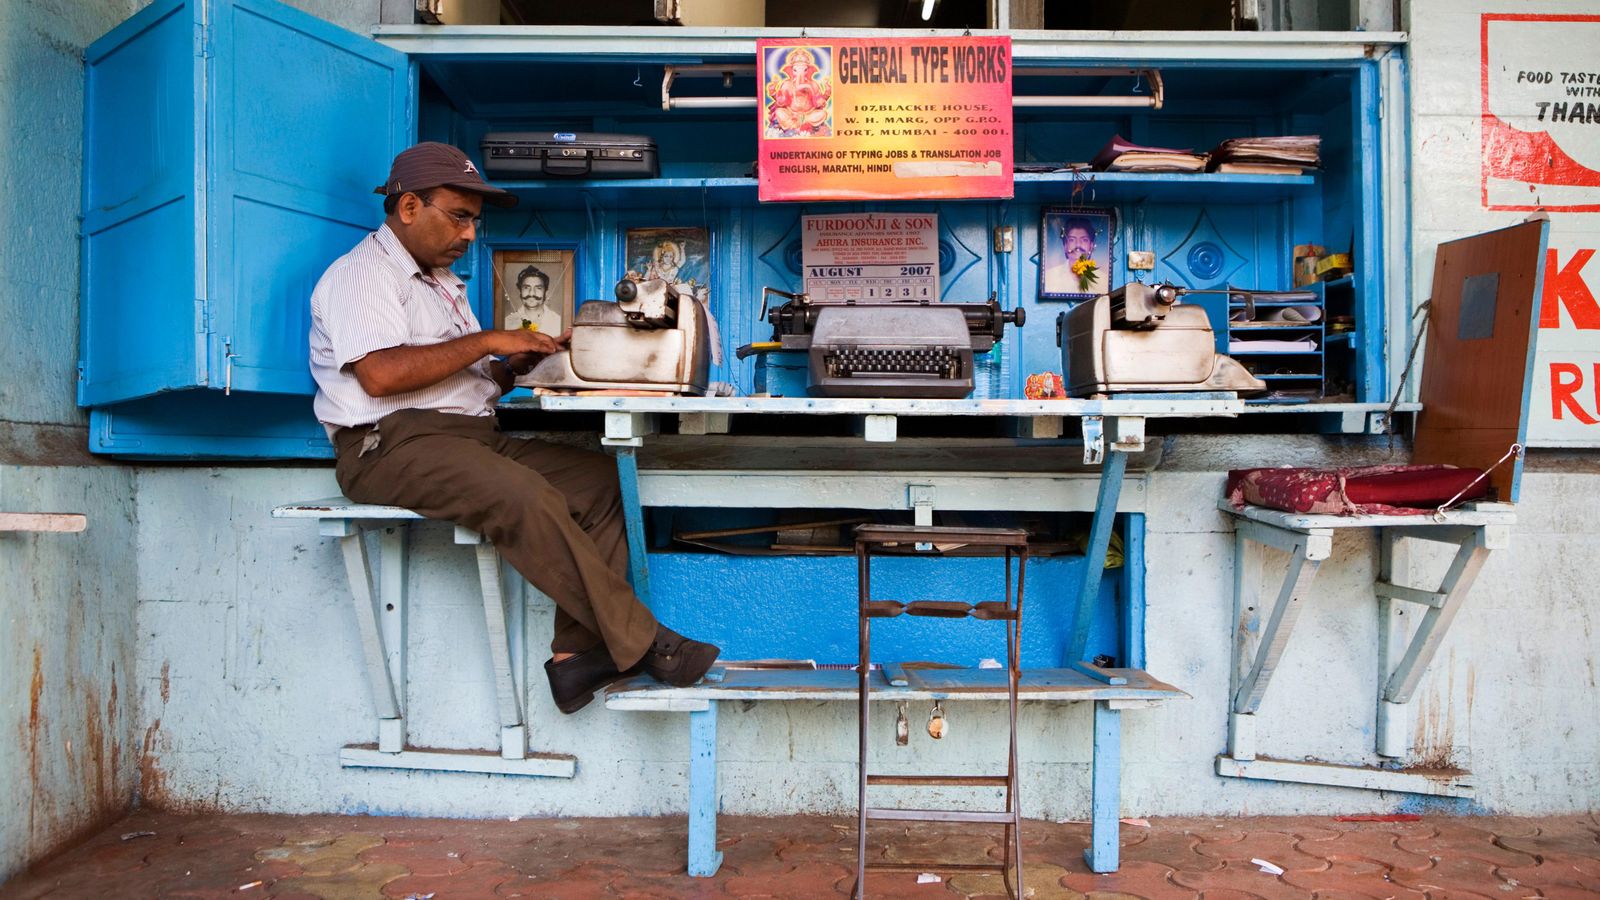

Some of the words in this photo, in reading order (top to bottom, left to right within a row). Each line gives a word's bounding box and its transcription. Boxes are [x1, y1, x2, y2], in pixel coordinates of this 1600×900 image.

[838, 46, 907, 84] GENERAL
[911, 46, 949, 83] TYPE
[952, 45, 1007, 83] WORKS
[1517, 70, 1553, 84] FOOD
[943, 104, 993, 113] HOUSE,
[884, 117, 929, 126] MARG,
[934, 116, 961, 124] OPP
[837, 129, 874, 138] FORT,
[880, 128, 937, 137] MUMBAI
[954, 127, 979, 136] 400
[770, 150, 834, 160] UNDERTAKING
[836, 150, 848, 159] OF
[850, 150, 883, 159] TYPING
[885, 149, 908, 159] JOBS
[911, 150, 918, 159] &
[920, 149, 982, 159] TRANSLATION
[984, 149, 1002, 158] JOB
[779, 164, 821, 175] ENGLISH,
[822, 164, 866, 175] MARATHI,
[867, 164, 892, 173] HINDI
[807, 218, 886, 231] FURDOONJI
[891, 218, 901, 230] &
[905, 218, 933, 230] SON
[816, 239, 848, 247] AHURA
[851, 238, 902, 246] INSURANCE
[810, 267, 863, 277] AUGUST
[901, 267, 931, 275] 2007
[903, 288, 910, 296] 3
[920, 287, 927, 295] 4
